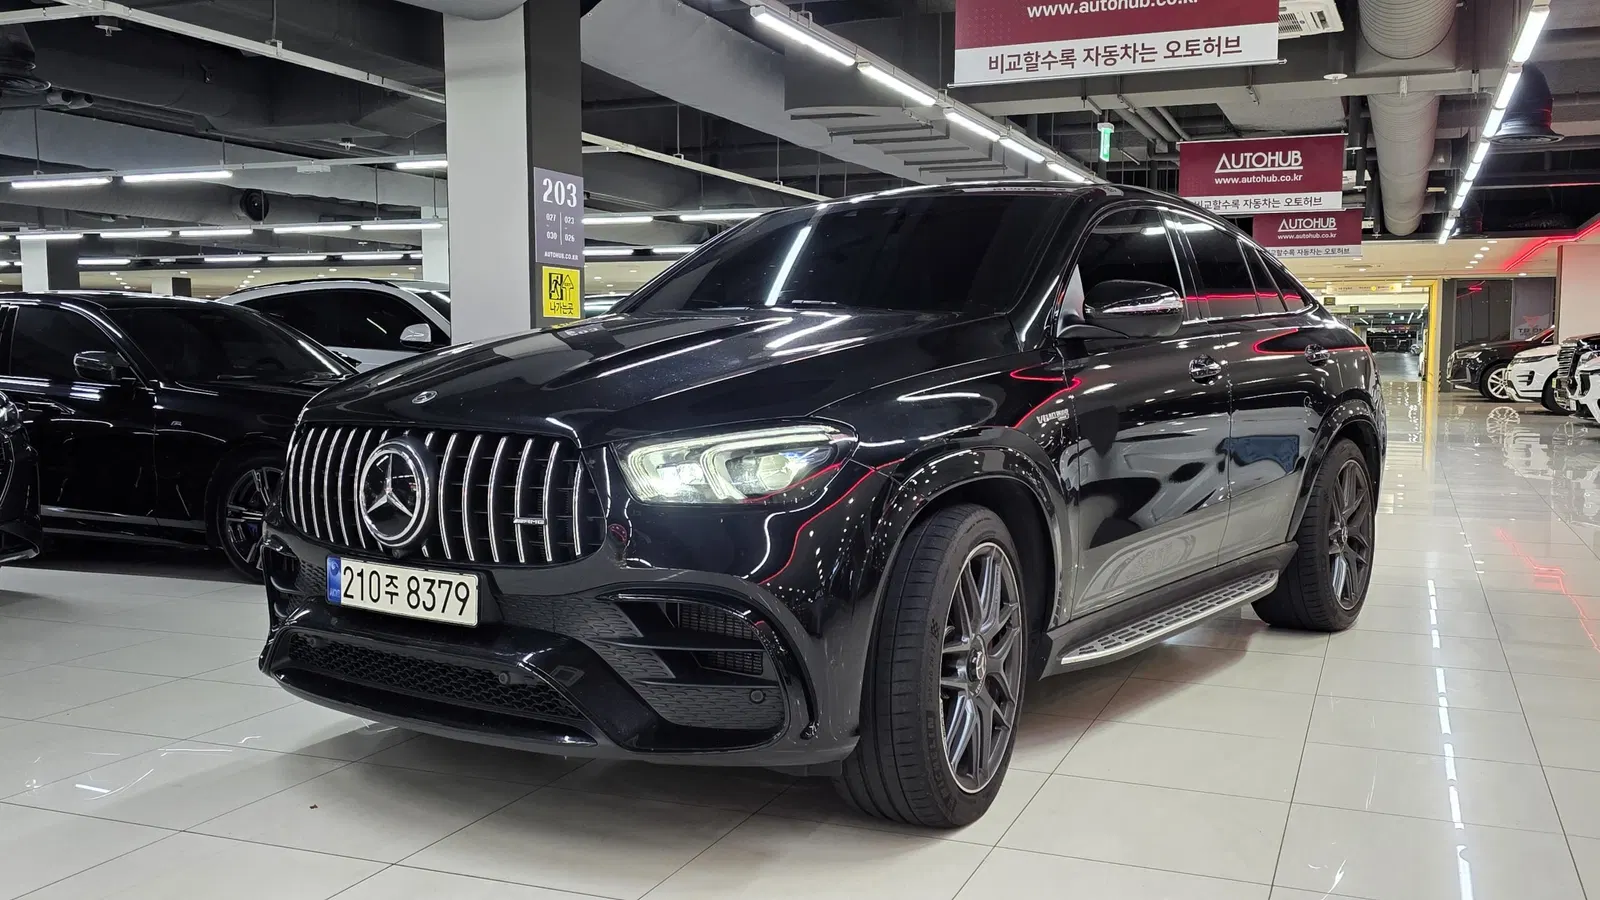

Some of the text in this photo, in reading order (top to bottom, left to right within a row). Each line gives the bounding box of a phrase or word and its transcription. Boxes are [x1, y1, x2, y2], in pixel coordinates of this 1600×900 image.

[989, 35, 1243, 75] 비교할수록 자동차는 오토허브
[1215, 150, 1303, 173] AUTOHUB
[1214, 173, 1303, 185] www.autohub.co.kr
[542, 178, 578, 208] 203
[1243, 198, 1282, 209] 자동차는
[1284, 196, 1323, 207] 오토허브
[545, 213, 556, 222] 027
[564, 215, 575, 225] 023
[1277, 217, 1338, 232] AUTOHUB
[546, 231, 558, 240] 030
[564, 233, 576, 242] 026
[1277, 232, 1337, 240] www.autohub.co.kr
[1297, 248, 1323, 256] 자동차는
[1324, 247, 1350, 255] 오토허브
[549, 301, 574, 315] 나가는곳
[343, 565, 470, 616] 210주 8379
